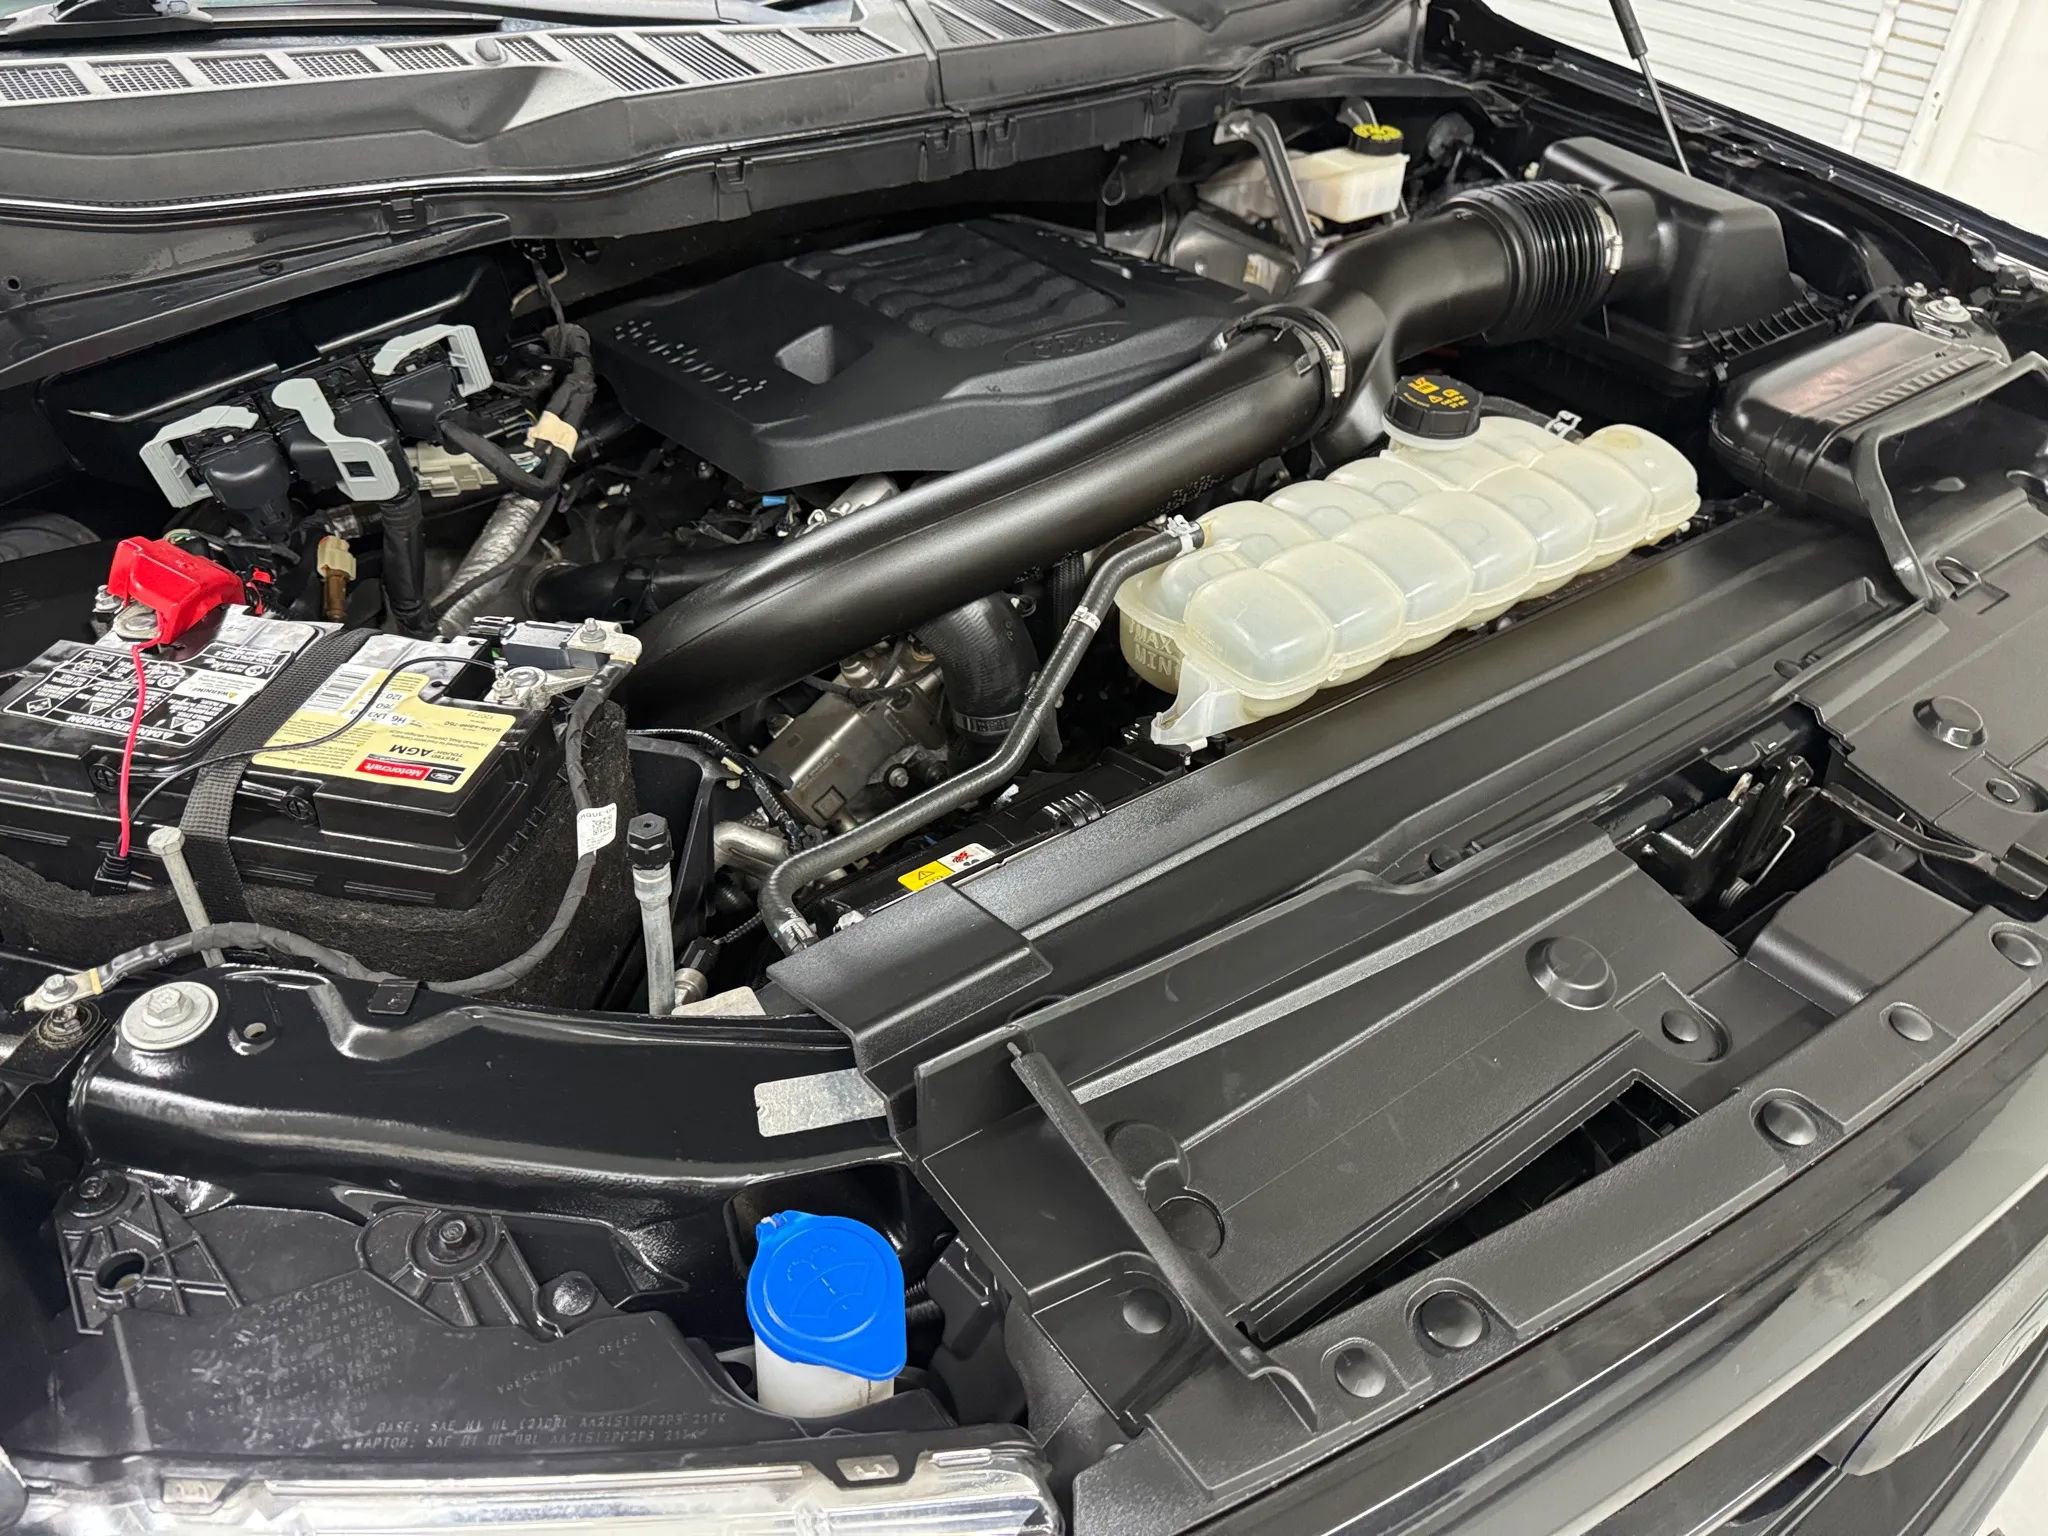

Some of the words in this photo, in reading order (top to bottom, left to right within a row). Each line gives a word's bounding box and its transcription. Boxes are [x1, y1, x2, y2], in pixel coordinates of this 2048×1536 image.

[1133, 624, 1173, 653] MAX
[1134, 644, 1172, 676] MIN
[386, 692, 402, 700] 120
[391, 715, 406, 723] H6
[387, 743, 433, 757] AGM
[363, 761, 424, 777] Motorcraft
